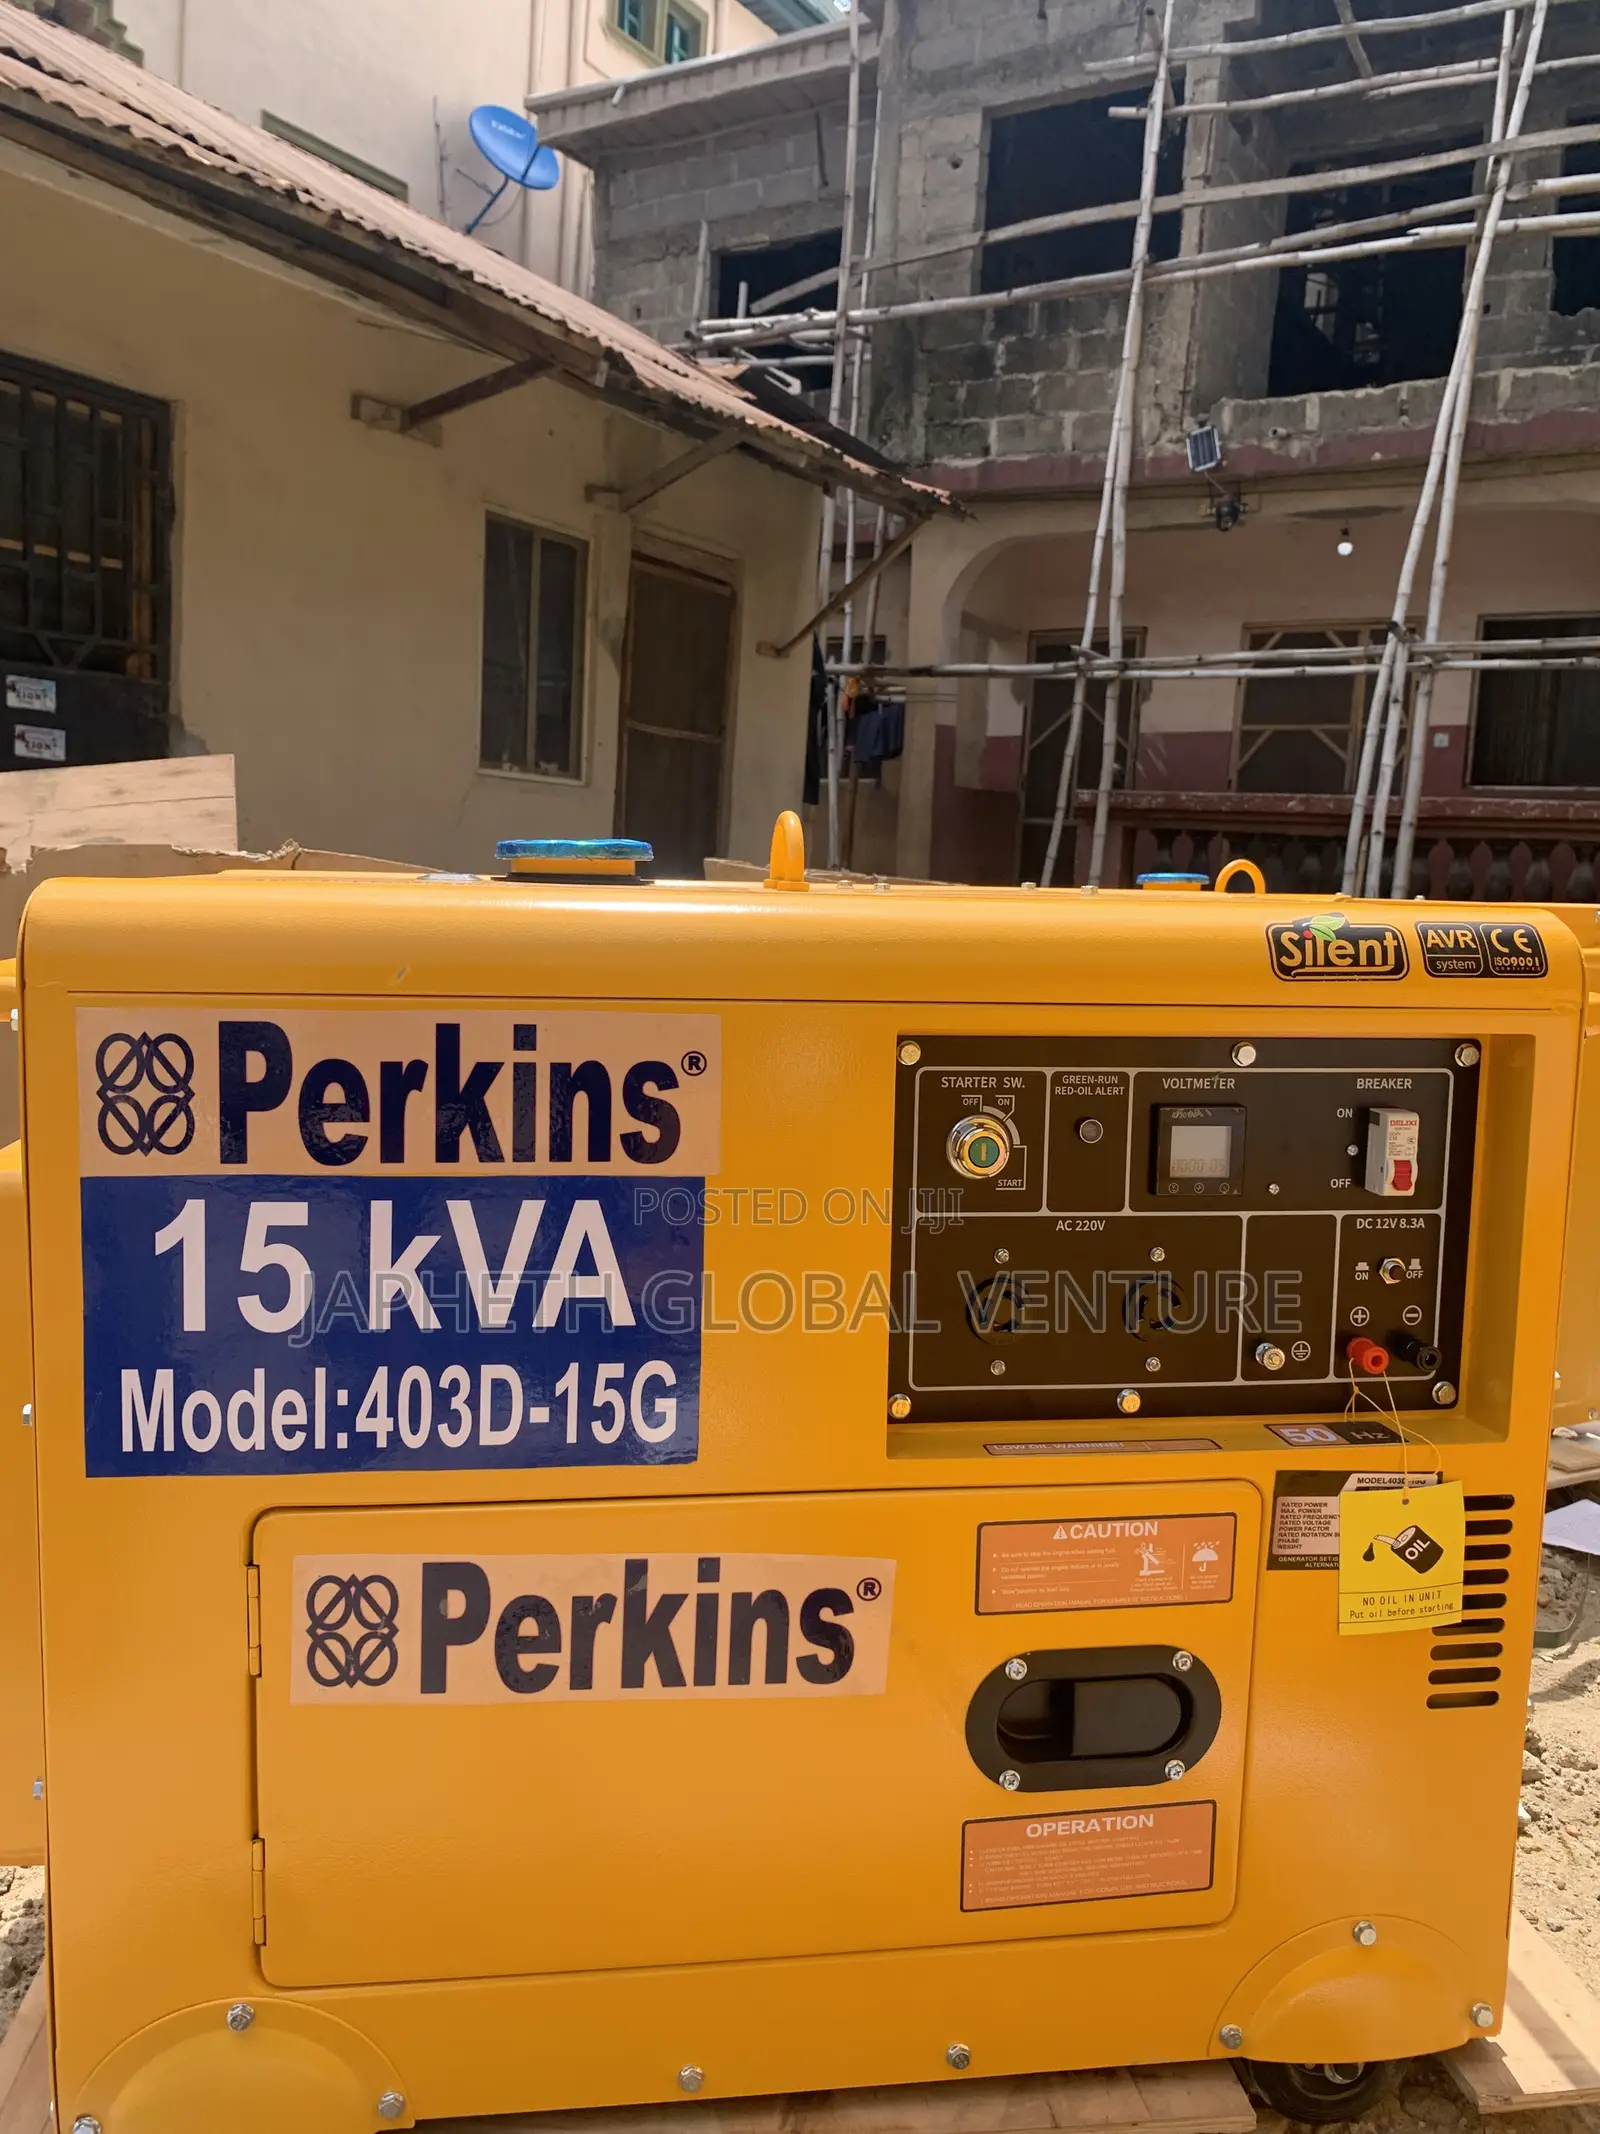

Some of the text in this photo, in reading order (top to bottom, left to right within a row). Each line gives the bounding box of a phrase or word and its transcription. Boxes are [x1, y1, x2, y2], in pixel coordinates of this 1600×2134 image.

[1427, 929, 1477, 949] AVR
[1280, 930, 1399, 967] Silent
[1436, 958, 1476, 971] system
[1493, 956, 1540, 967] ISO9001
[941, 1076, 1026, 1088] STARTER SW.
[1062, 1075, 1118, 1085] GREEN-RUN
[1162, 1077, 1236, 1090] VOLTMETER
[1356, 1078, 1413, 1090] BREAKER
[1054, 1086, 1125, 1096] RED-OIL ALERT
[962, 1097, 979, 1106] OFF
[997, 1097, 1010, 1106] ON
[1336, 1108, 1353, 1118] ON
[997, 1179, 1023, 1187] START
[1330, 1178, 1352, 1189] OFF
[1056, 1219, 1106, 1231] AC 220V
[1356, 1218, 1425, 1229] DC 12V 8.3A
[154, 1199, 637, 1334] 15 kVA
[1354, 1272, 1369, 1281] ON
[1406, 1270, 1424, 1279] OFF
[120, 1359, 679, 1453] Model:403D-15G
[1280, 1427, 1389, 1443] 50 Hz
[1070, 1520, 1159, 1540] CAUTION
[1405, 1539, 1431, 1560] OIL
[1362, 1590, 1442, 1606] NO OIL IN UNIT
[1350, 1602, 1454, 1619] Put oil before starting
[1026, 1814, 1154, 1838] OPERATION
